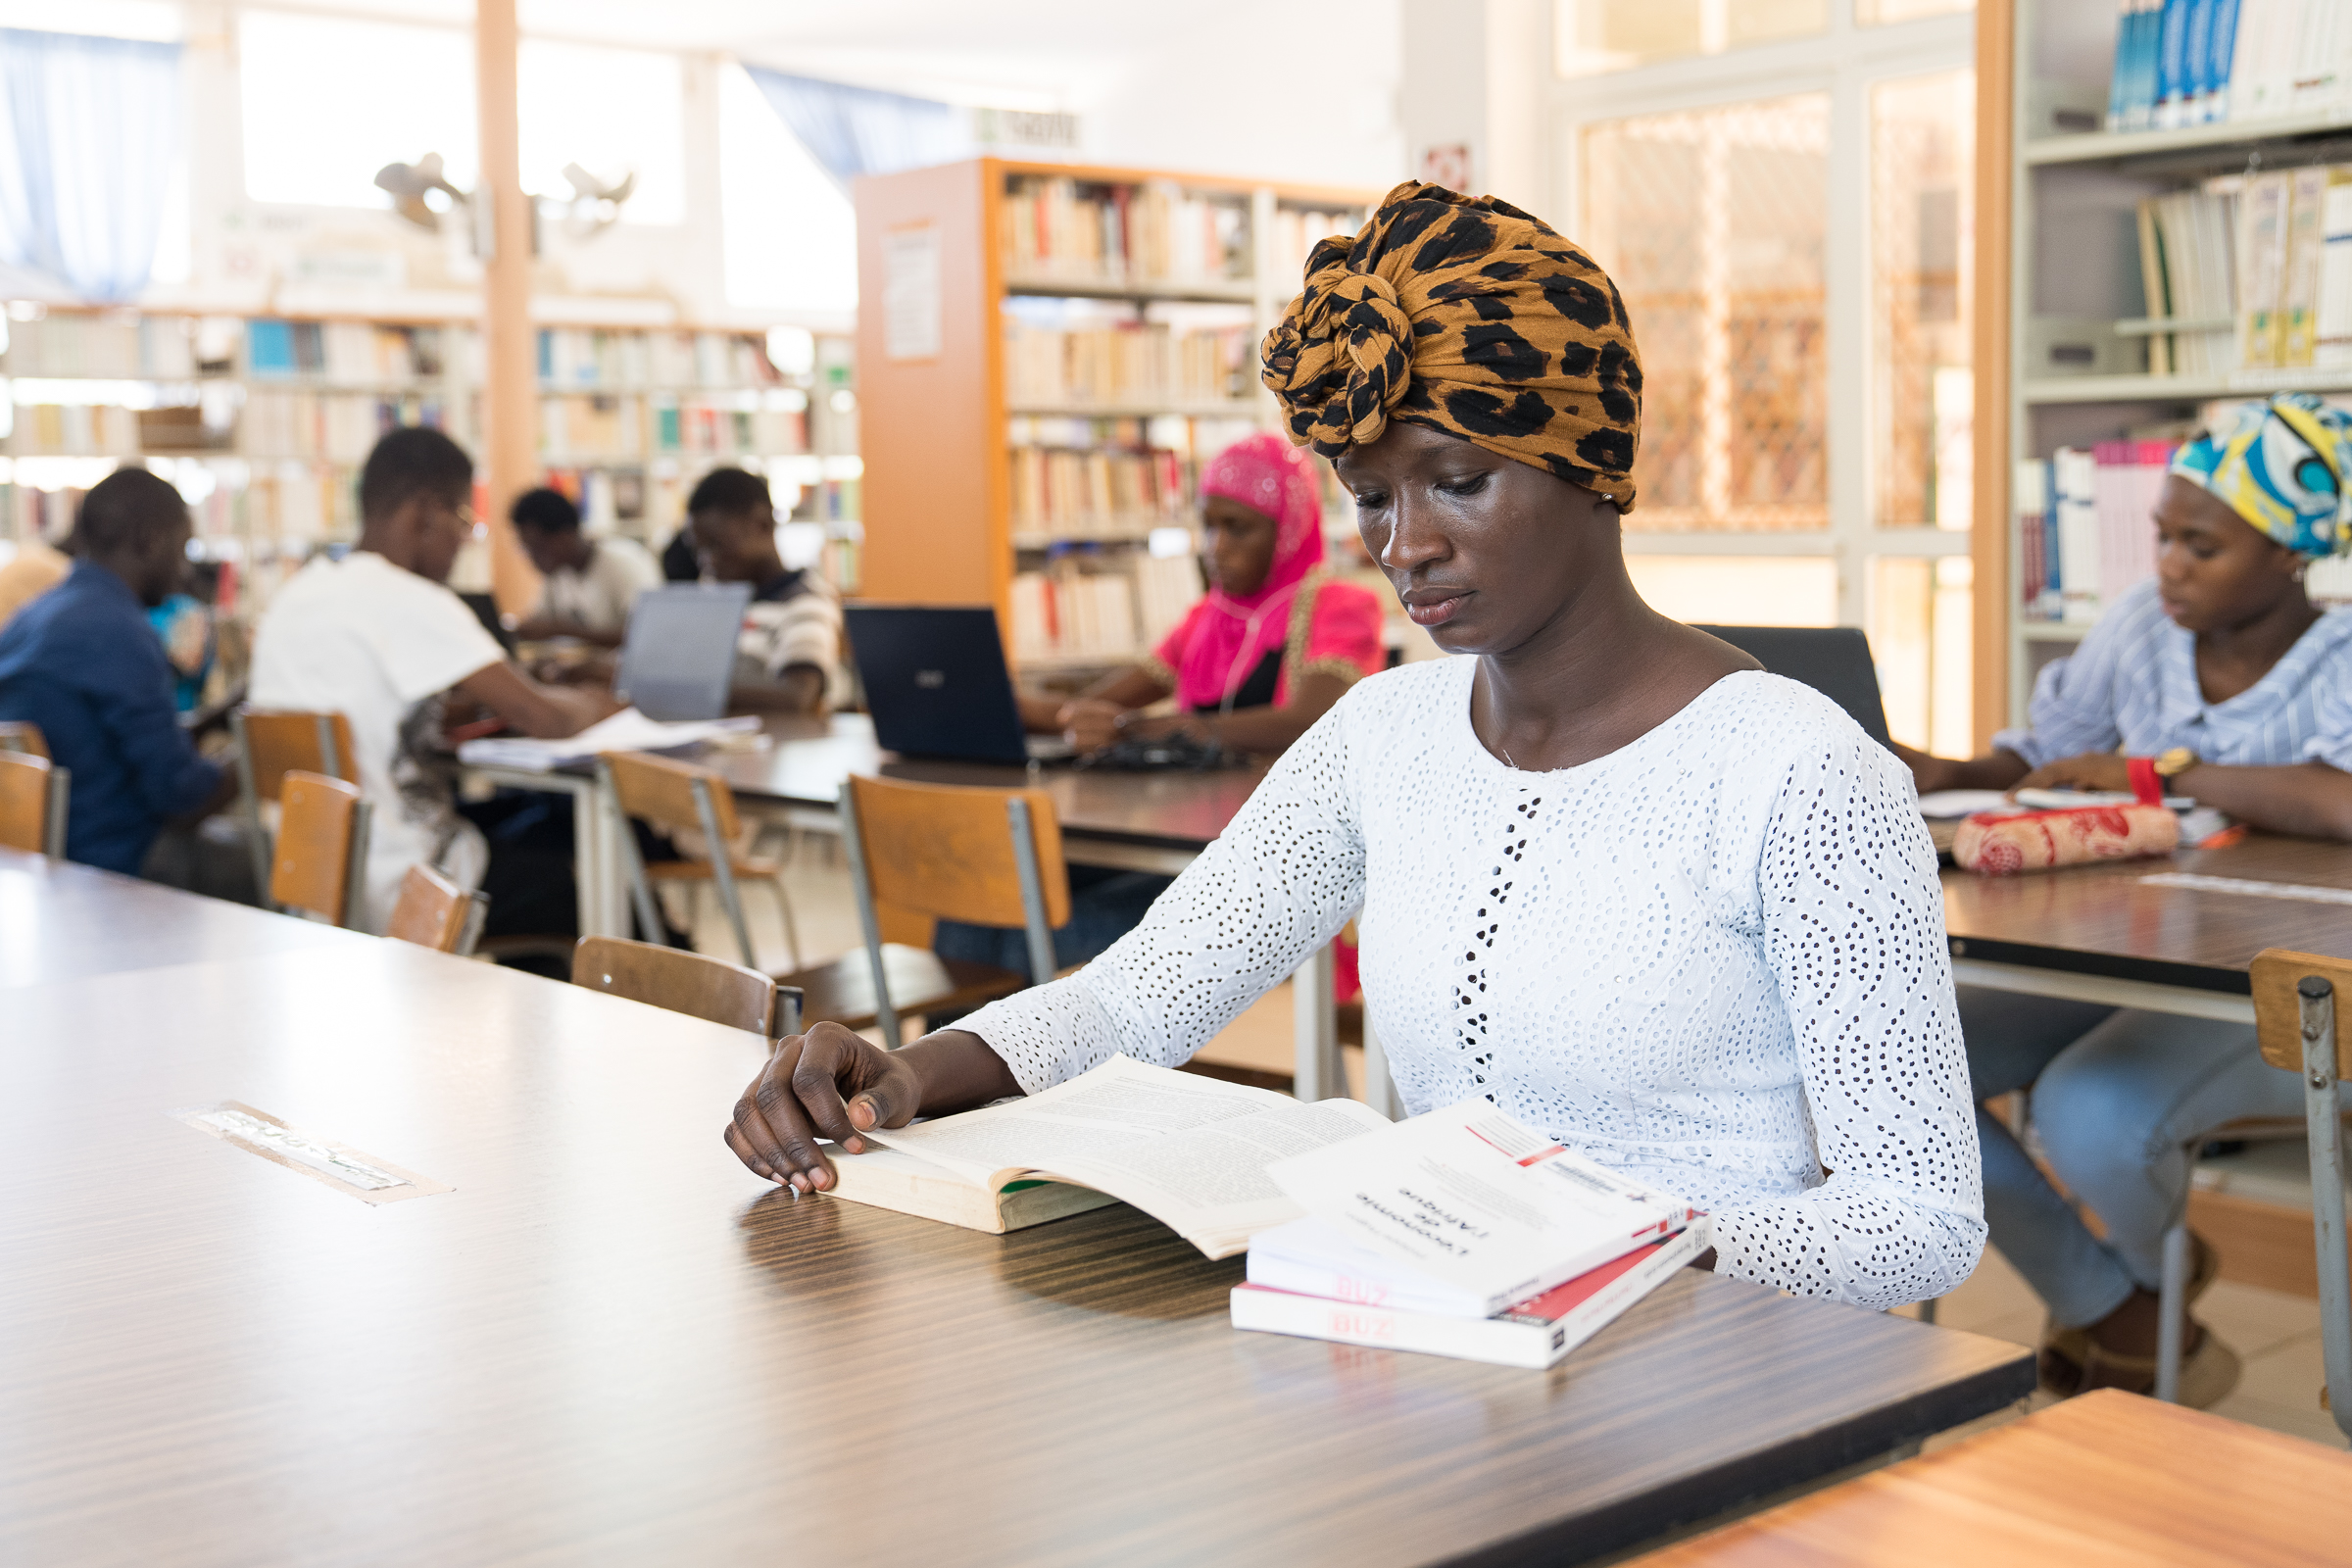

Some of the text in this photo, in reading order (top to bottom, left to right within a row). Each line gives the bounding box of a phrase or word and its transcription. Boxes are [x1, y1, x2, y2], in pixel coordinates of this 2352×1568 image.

[1397, 1187, 1491, 1239] l'Afrique
[1412, 1211, 1441, 1228] de
[1333, 1312, 1392, 1340] BUZ
